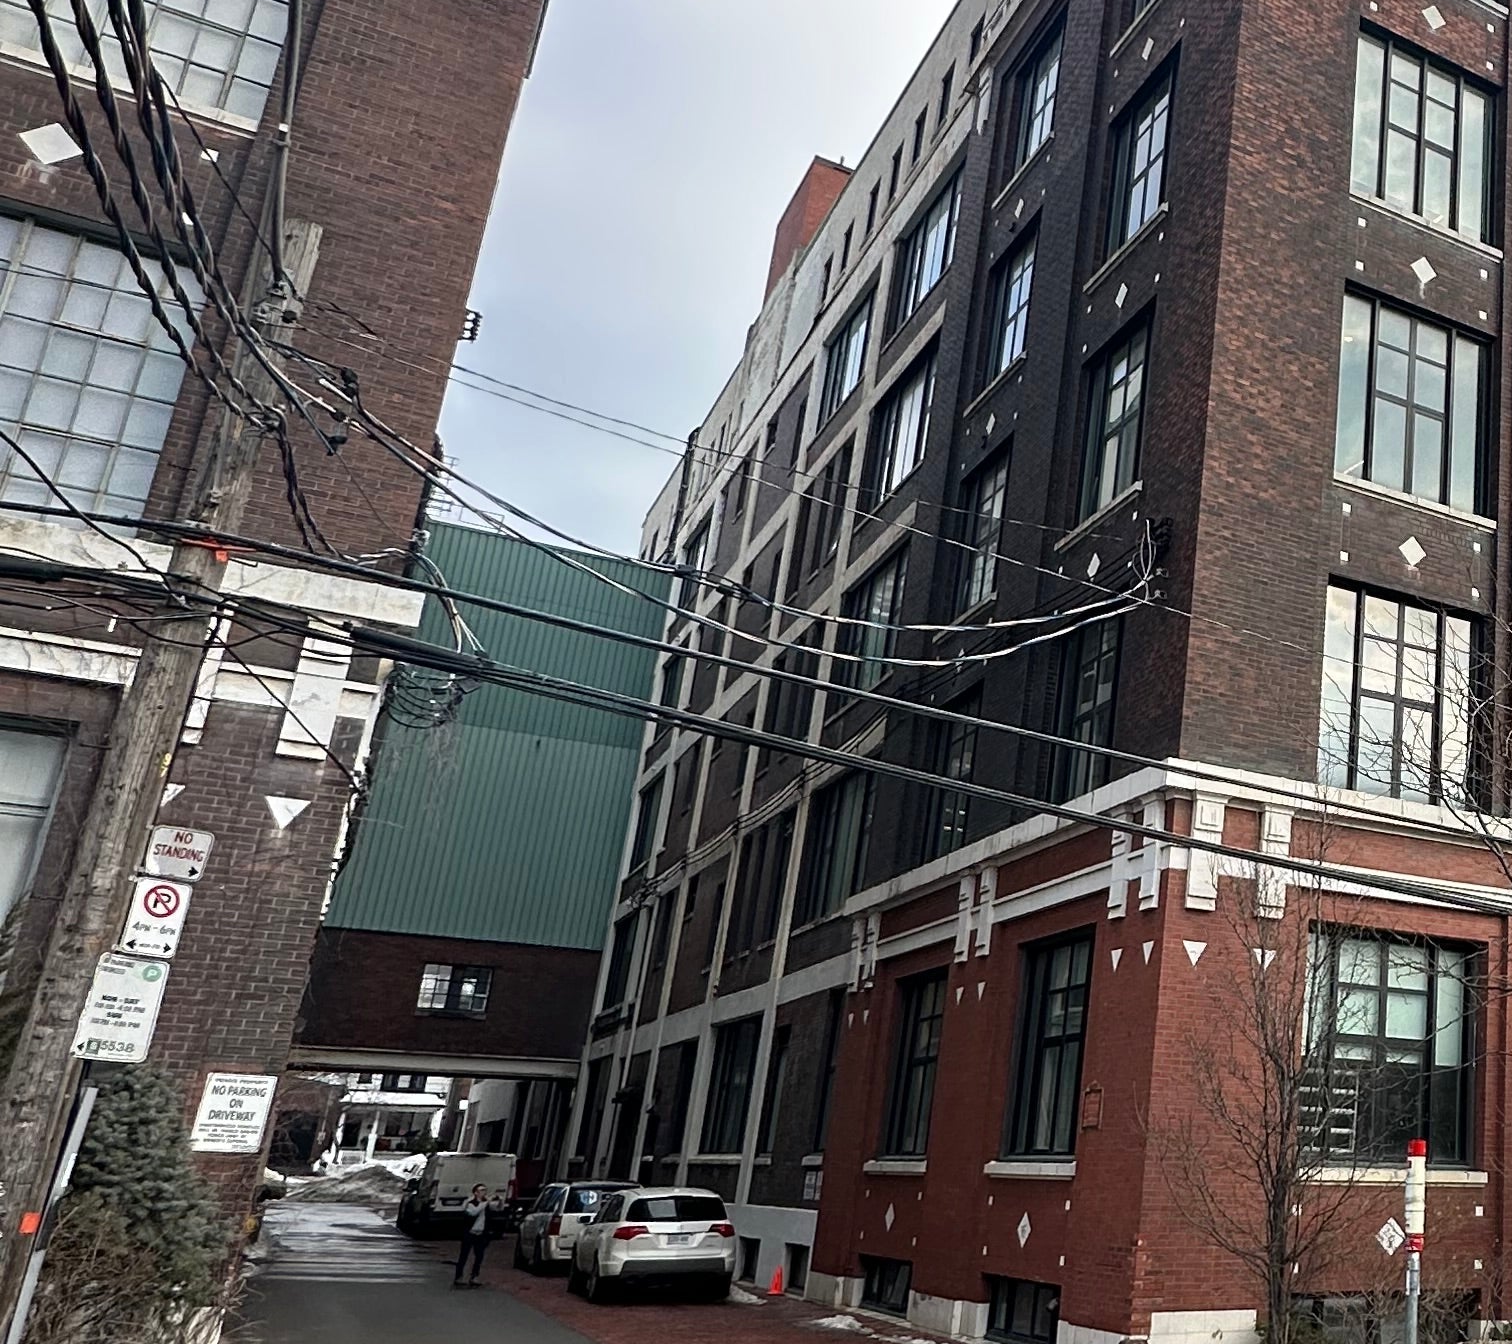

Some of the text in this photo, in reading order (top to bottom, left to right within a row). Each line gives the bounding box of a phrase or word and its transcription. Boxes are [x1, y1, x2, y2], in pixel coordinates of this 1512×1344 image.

[174, 831, 194, 845] NO
[153, 844, 206, 863] STANDING
[99, 1039, 135, 1053] 5538
[211, 1085, 268, 1098] NO PARKING
[229, 1098, 244, 1109] ON
[208, 1109, 257, 1122] DRIVEWAY
